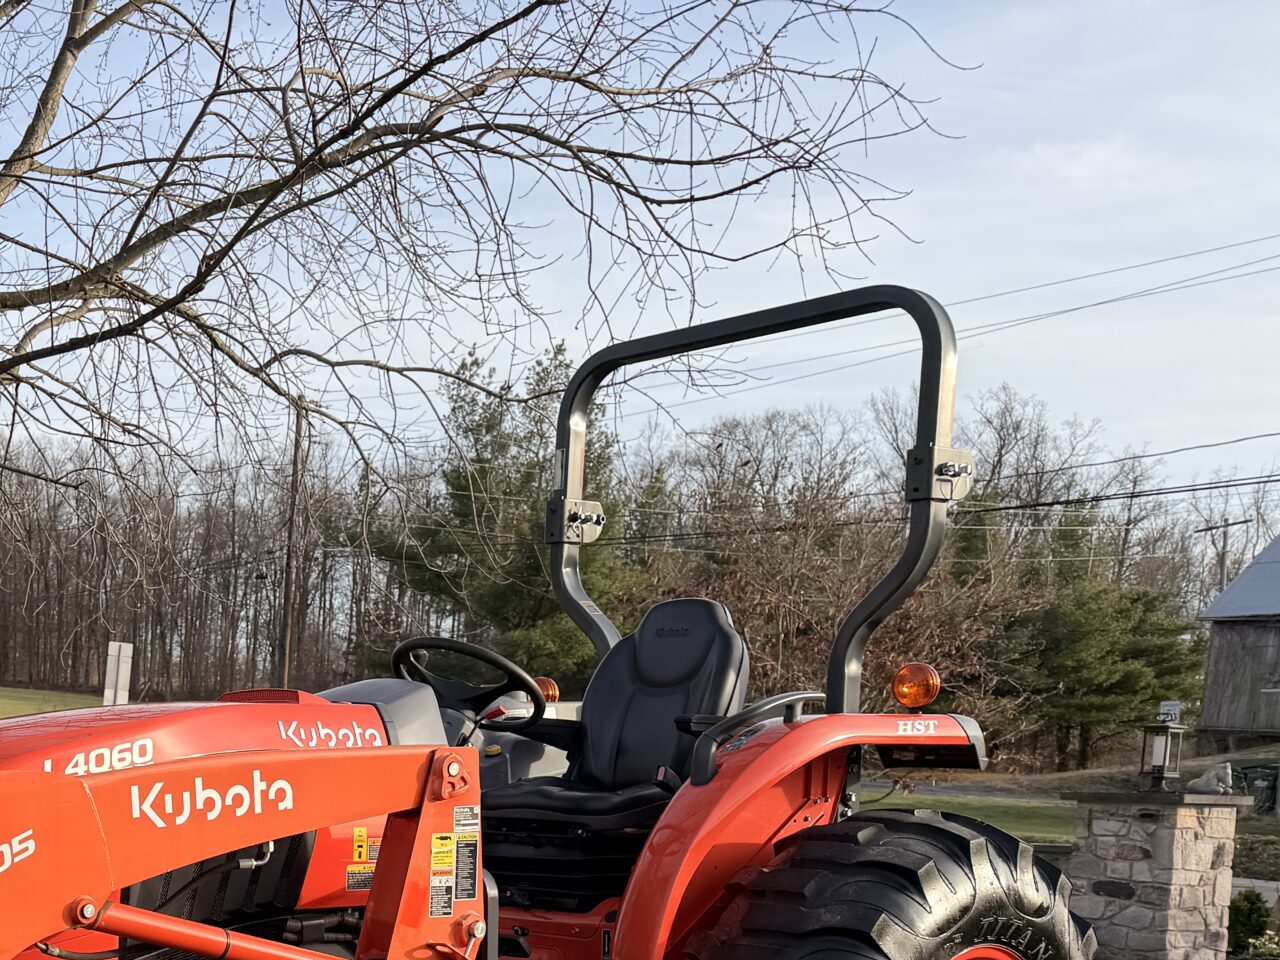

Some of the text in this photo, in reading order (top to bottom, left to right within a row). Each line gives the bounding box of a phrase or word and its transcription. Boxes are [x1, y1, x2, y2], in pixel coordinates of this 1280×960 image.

[278, 720, 382, 747] Kubota
[896, 720, 938, 735] HST
[130, 769, 294, 828] Kubota
